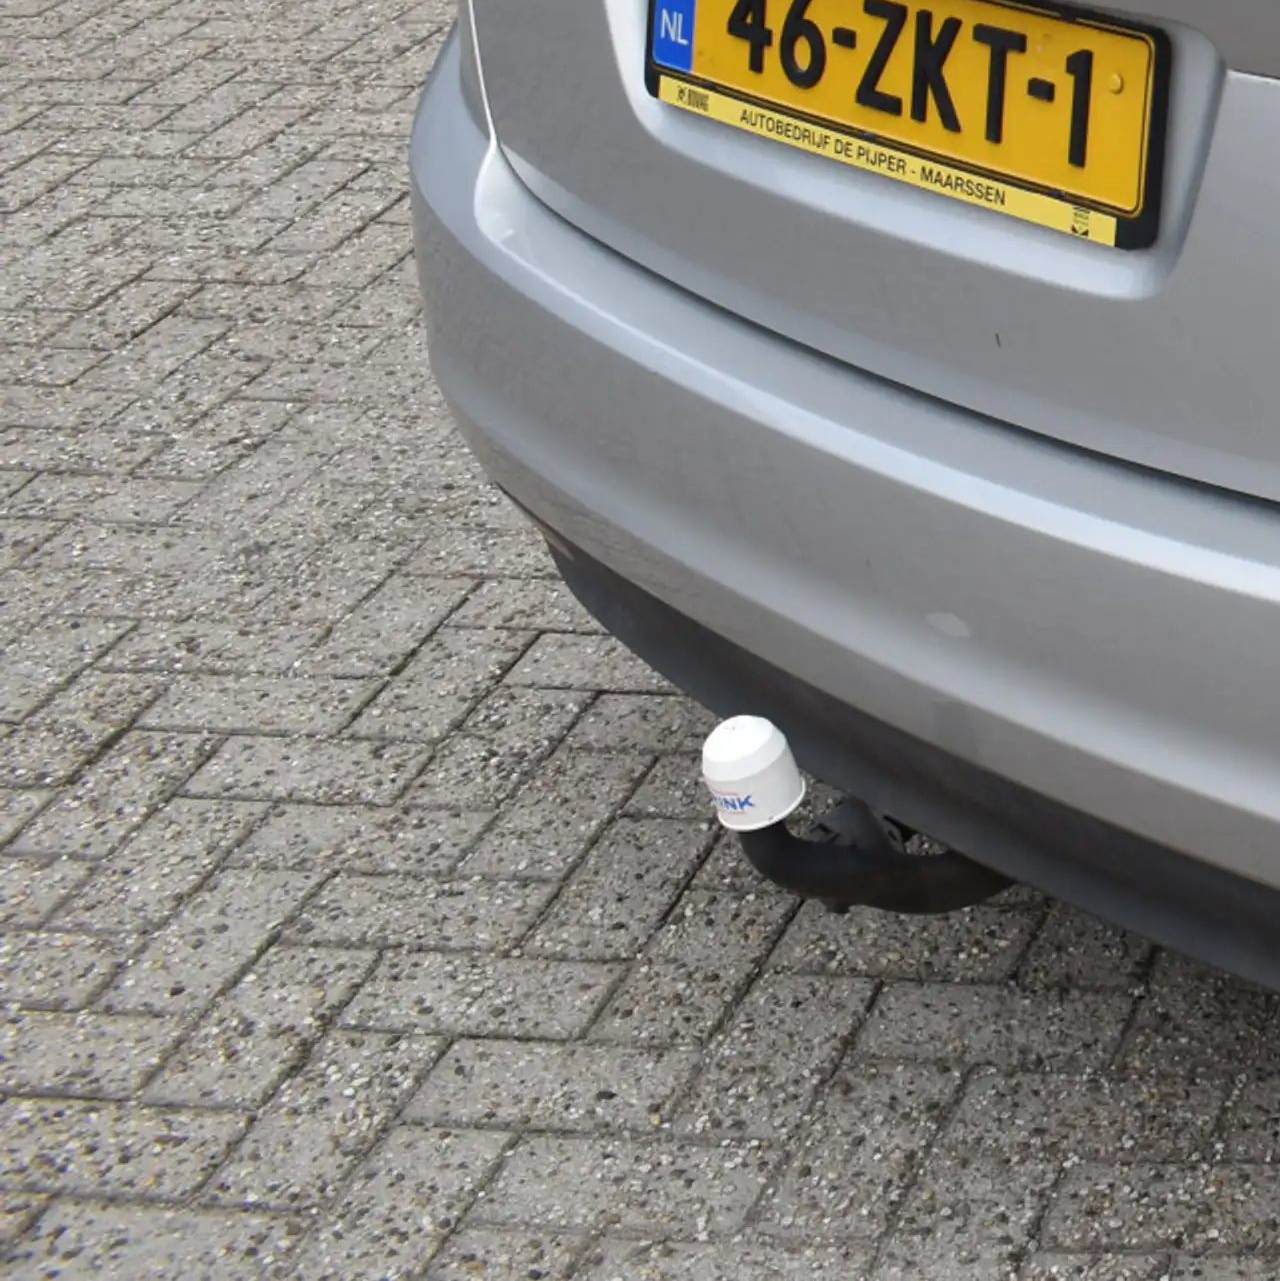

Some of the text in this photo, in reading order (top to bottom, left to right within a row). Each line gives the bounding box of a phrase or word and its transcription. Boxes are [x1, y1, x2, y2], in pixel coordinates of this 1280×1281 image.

[659, 8, 690, 47] NL
[740, 108, 830, 150] AUTOBEDRIJF
[834, 137, 853, 159] DE
[856, 144, 907, 176] PIJPER
[920, 166, 1006, 207] MAARSSEN
